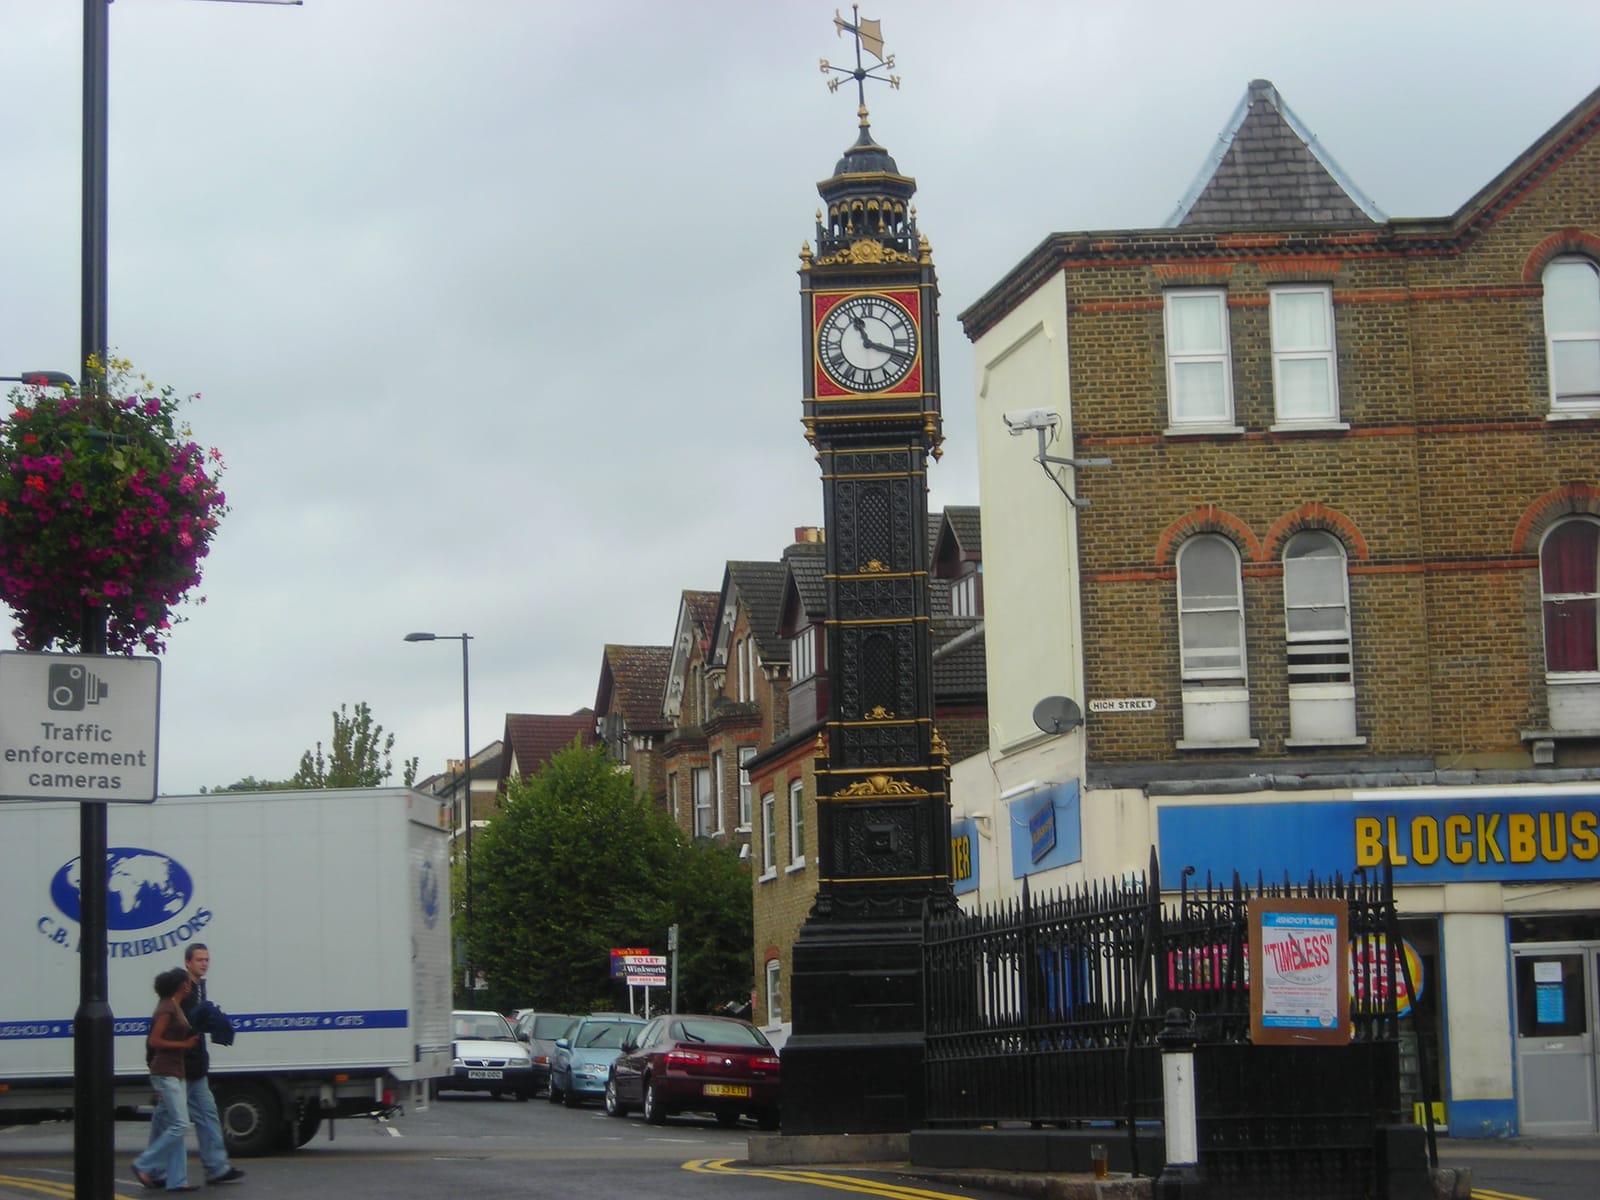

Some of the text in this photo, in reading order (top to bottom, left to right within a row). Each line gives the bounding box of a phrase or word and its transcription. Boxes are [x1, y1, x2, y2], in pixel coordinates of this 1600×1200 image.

[1093, 700, 1153, 710] HIGH STREET
[41, 722, 113, 742] Traffic
[4, 745, 147, 767] enforcement
[28, 772, 122, 789] cameras
[1355, 811, 1599, 867] BLOCKBUS
[37, 916, 70, 948] C.B.
[626, 964, 666, 975] Winkworth
[253, 1016, 320, 1028] STATIONERY
[335, 1015, 364, 1026] GIFTS
